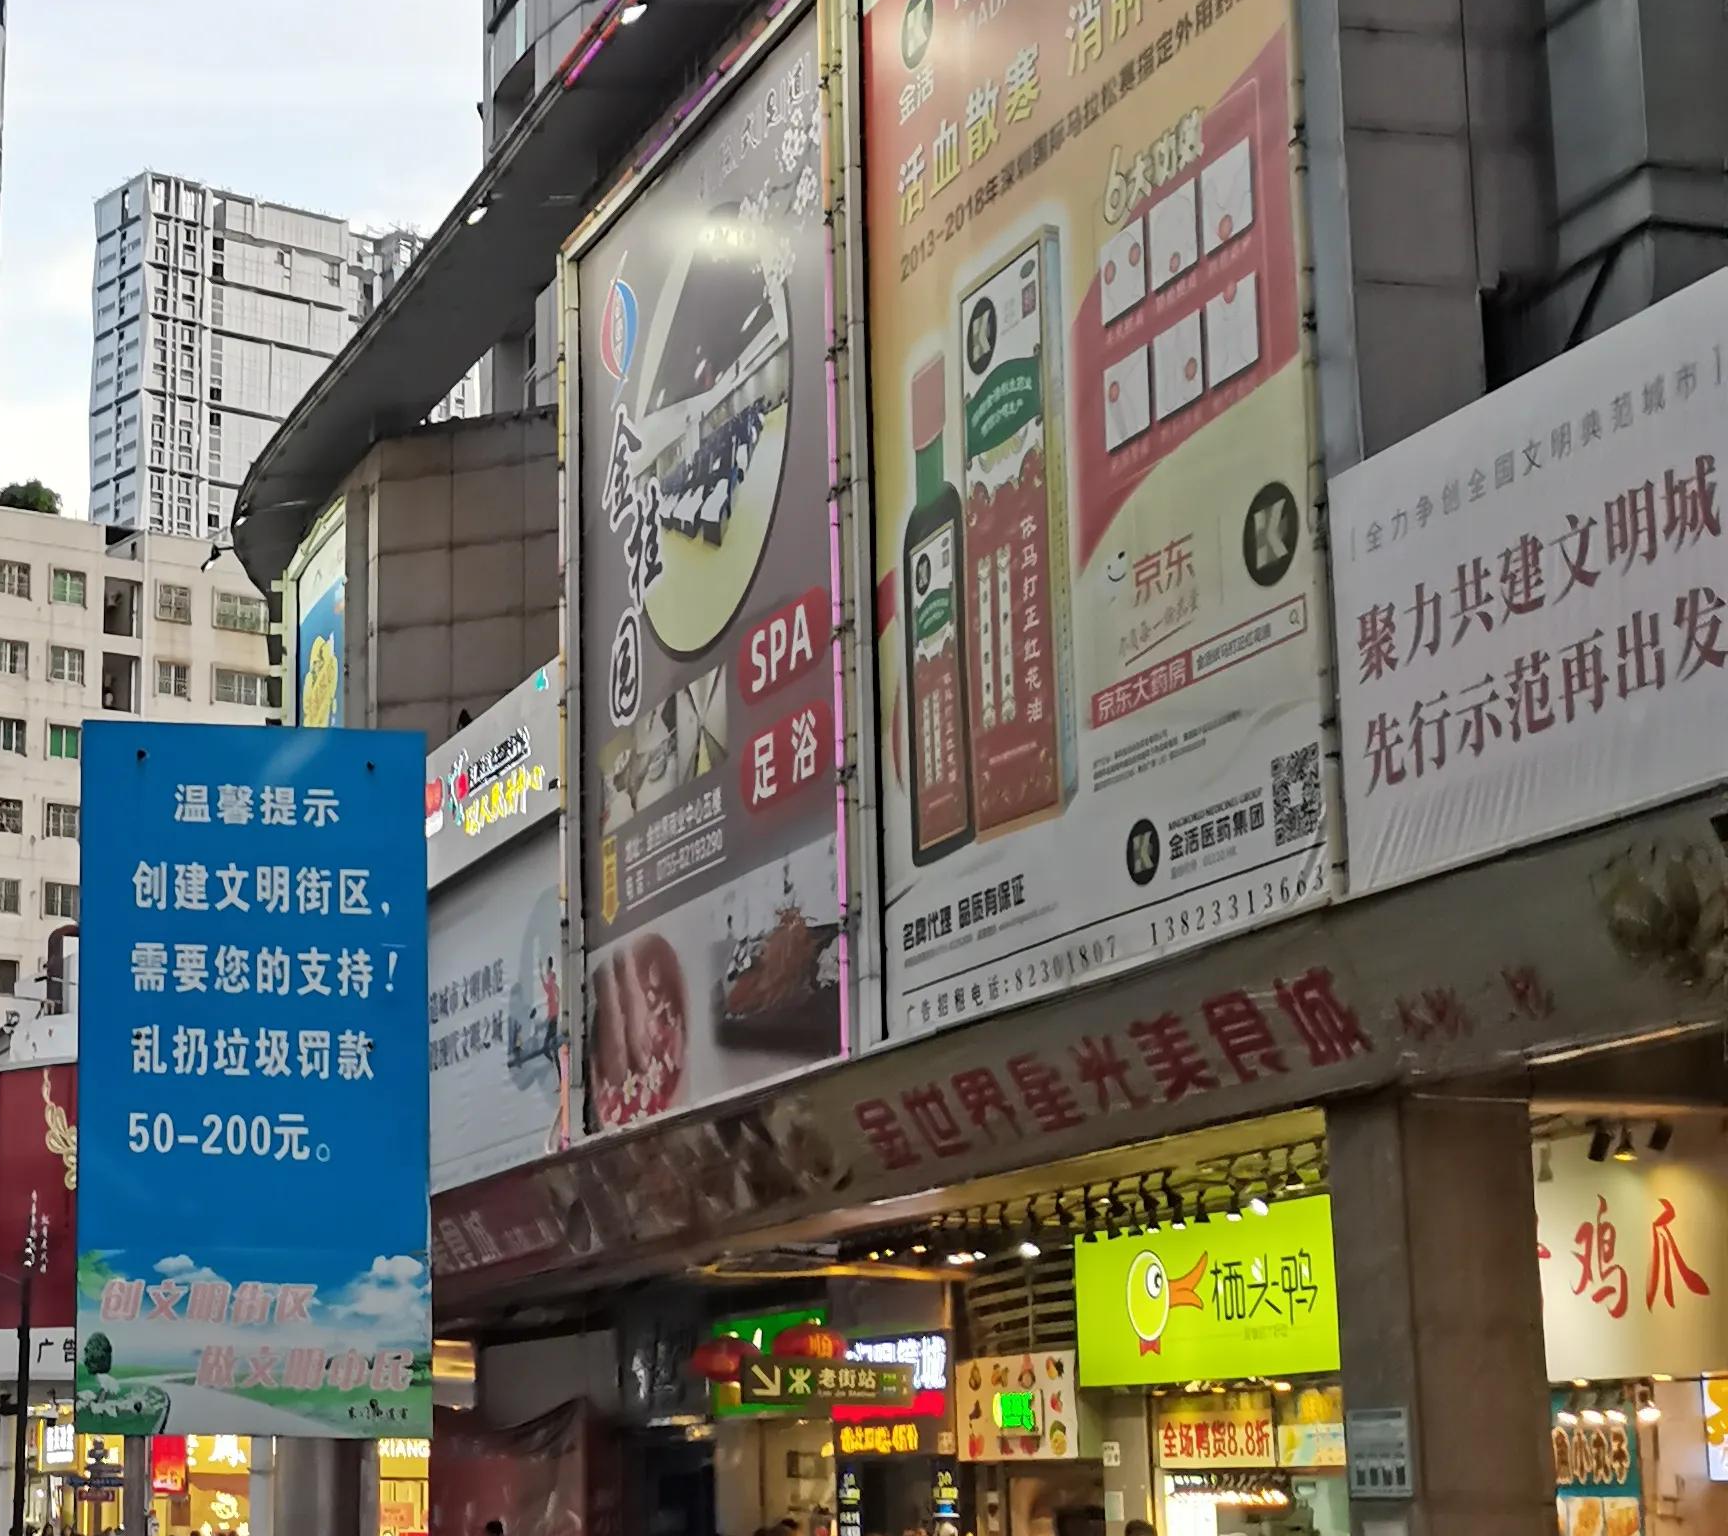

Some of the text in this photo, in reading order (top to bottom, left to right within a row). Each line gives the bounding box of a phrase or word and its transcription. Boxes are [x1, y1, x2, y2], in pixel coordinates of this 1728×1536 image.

[898, 63, 934, 125] 金活
[898, 42, 1040, 227] 活血散寒
[1364, 359, 1698, 554] 全力争创全国文明典范城市
[1133, 533, 1196, 608] 京东
[1357, 454, 1723, 686] 聚力共建文明城
[751, 603, 814, 695] SPA
[1098, 658, 1187, 721] 京东大药房
[1365, 586, 1728, 798] 先行示范再出发
[752, 709, 818, 807] 足浴
[173, 783, 341, 829] 温馨提示
[1169, 802, 1265, 862] 金活医药集团
[131, 860, 391, 918] 创建文明街区,
[958, 873, 1026, 930] 品质有保证
[130, 941, 399, 1000] 需要您的支持!
[130, 1025, 375, 1082] 乱扔垃圾罚款
[854, 965, 1376, 1170] 金世界星光美食城
[127, 1111, 333, 1164] 50-200元。
[1537, 1195, 1711, 1320] 鸡爪
[100, 1278, 320, 1324] 创文明街区
[195, 1344, 415, 1392] 做文明市民
[818, 1367, 877, 1390] 老街站
[378, 1438, 431, 1458] XIANG
[1162, 1418, 1272, 1459] 全场鸭货8.8折
